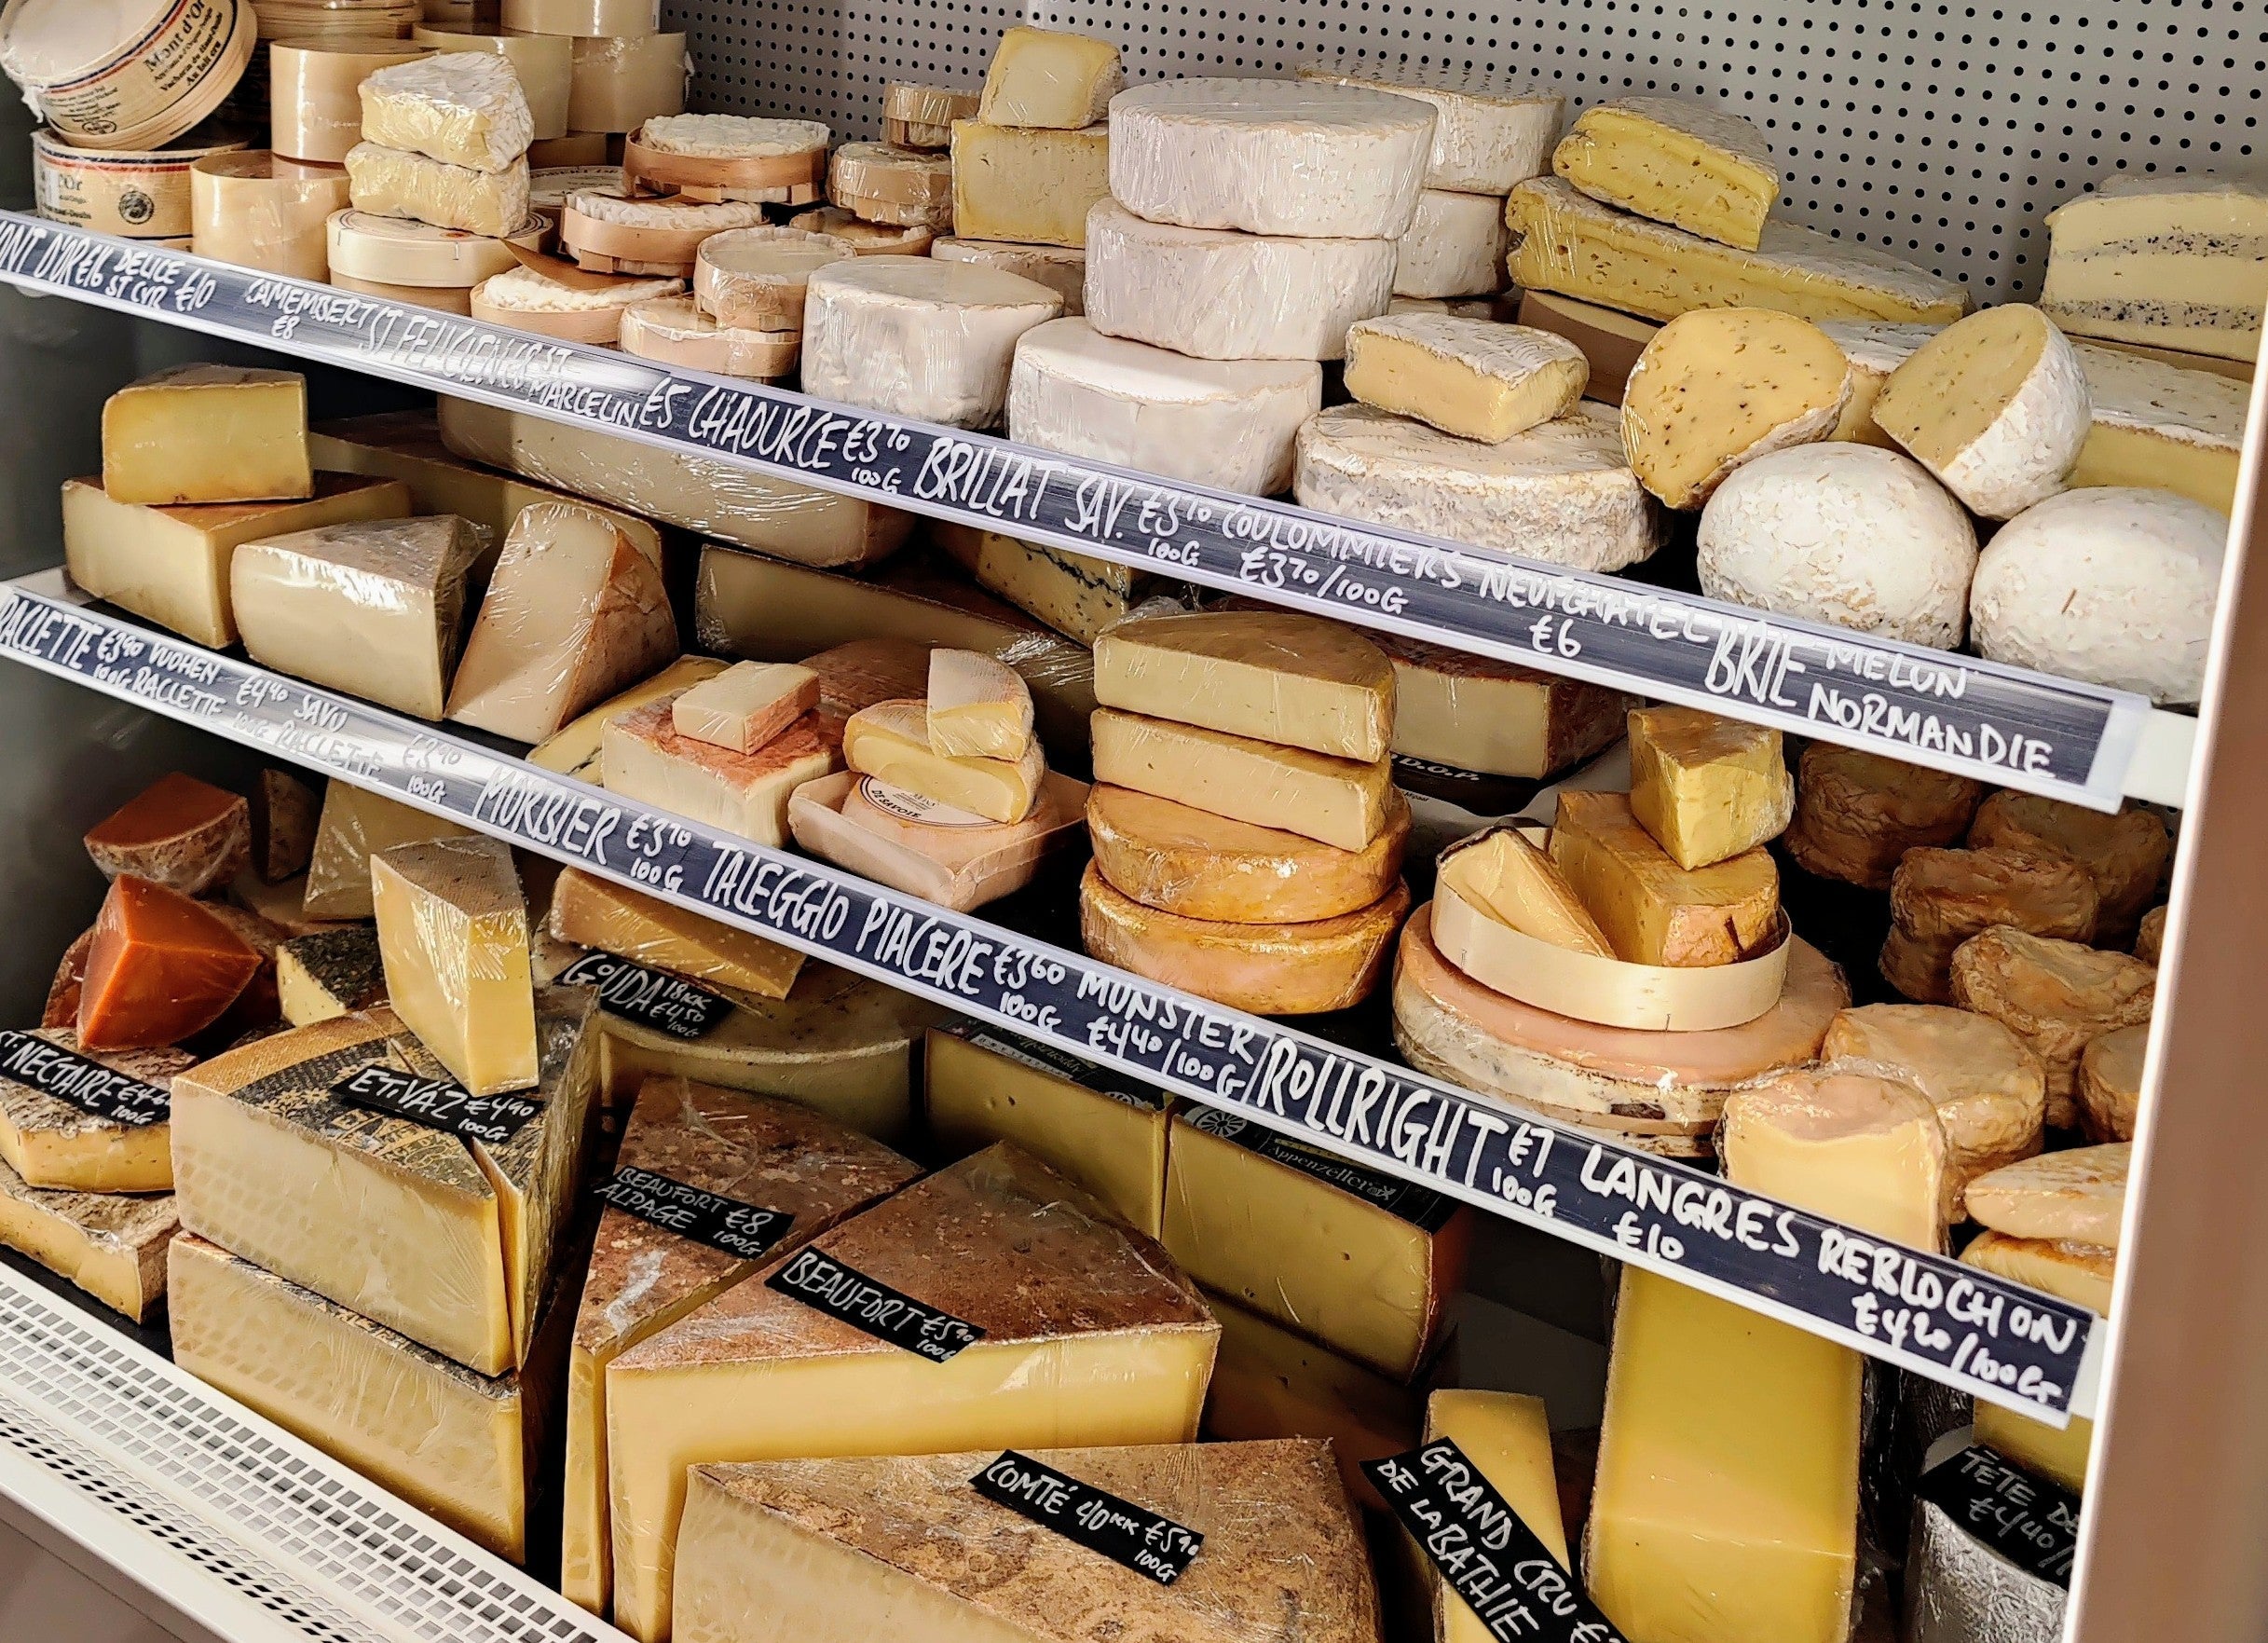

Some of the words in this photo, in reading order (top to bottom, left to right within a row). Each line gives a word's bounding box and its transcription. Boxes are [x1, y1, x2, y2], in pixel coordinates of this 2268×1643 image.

[105, 275, 133, 298] ST
[912, 435, 1069, 521] BRILLAT
[1824, 644, 1967, 699] MELUN
[1807, 682, 2056, 778] NORMANDIE
[471, 765, 622, 866] MORBIER
[630, 856, 684, 895] 100G
[702, 840, 851, 941] TALEGGIO
[855, 897, 993, 995] PIACERE
[562, 953, 666, 1012] GOUDA
[999, 991, 1062, 1033] 100G
[1076, 969, 1257, 1066] MUNSTER
[2, 1040, 130, 1107] NECTAIRE
[110, 1104, 156, 1126] 100G
[458, 1117, 510, 1142] 100G
[1256, 1036, 1510, 1188] ROLLRIGHT
[593, 1183, 698, 1229] ALPAGE
[616, 1166, 729, 1213] BEAUFORT
[1492, 1166, 1559, 1219] 100G
[1579, 1143, 1801, 1259] LANGRES
[712, 1230, 762, 1255] 100G
[781, 1251, 926, 1332] BEAUFORT
[1376, 1458, 1419, 1494] DE
[1420, 1445, 1513, 1551] GRAND
[1513, 1559, 1578, 1616] CRU
[1133, 1548, 1178, 1582] 100G
